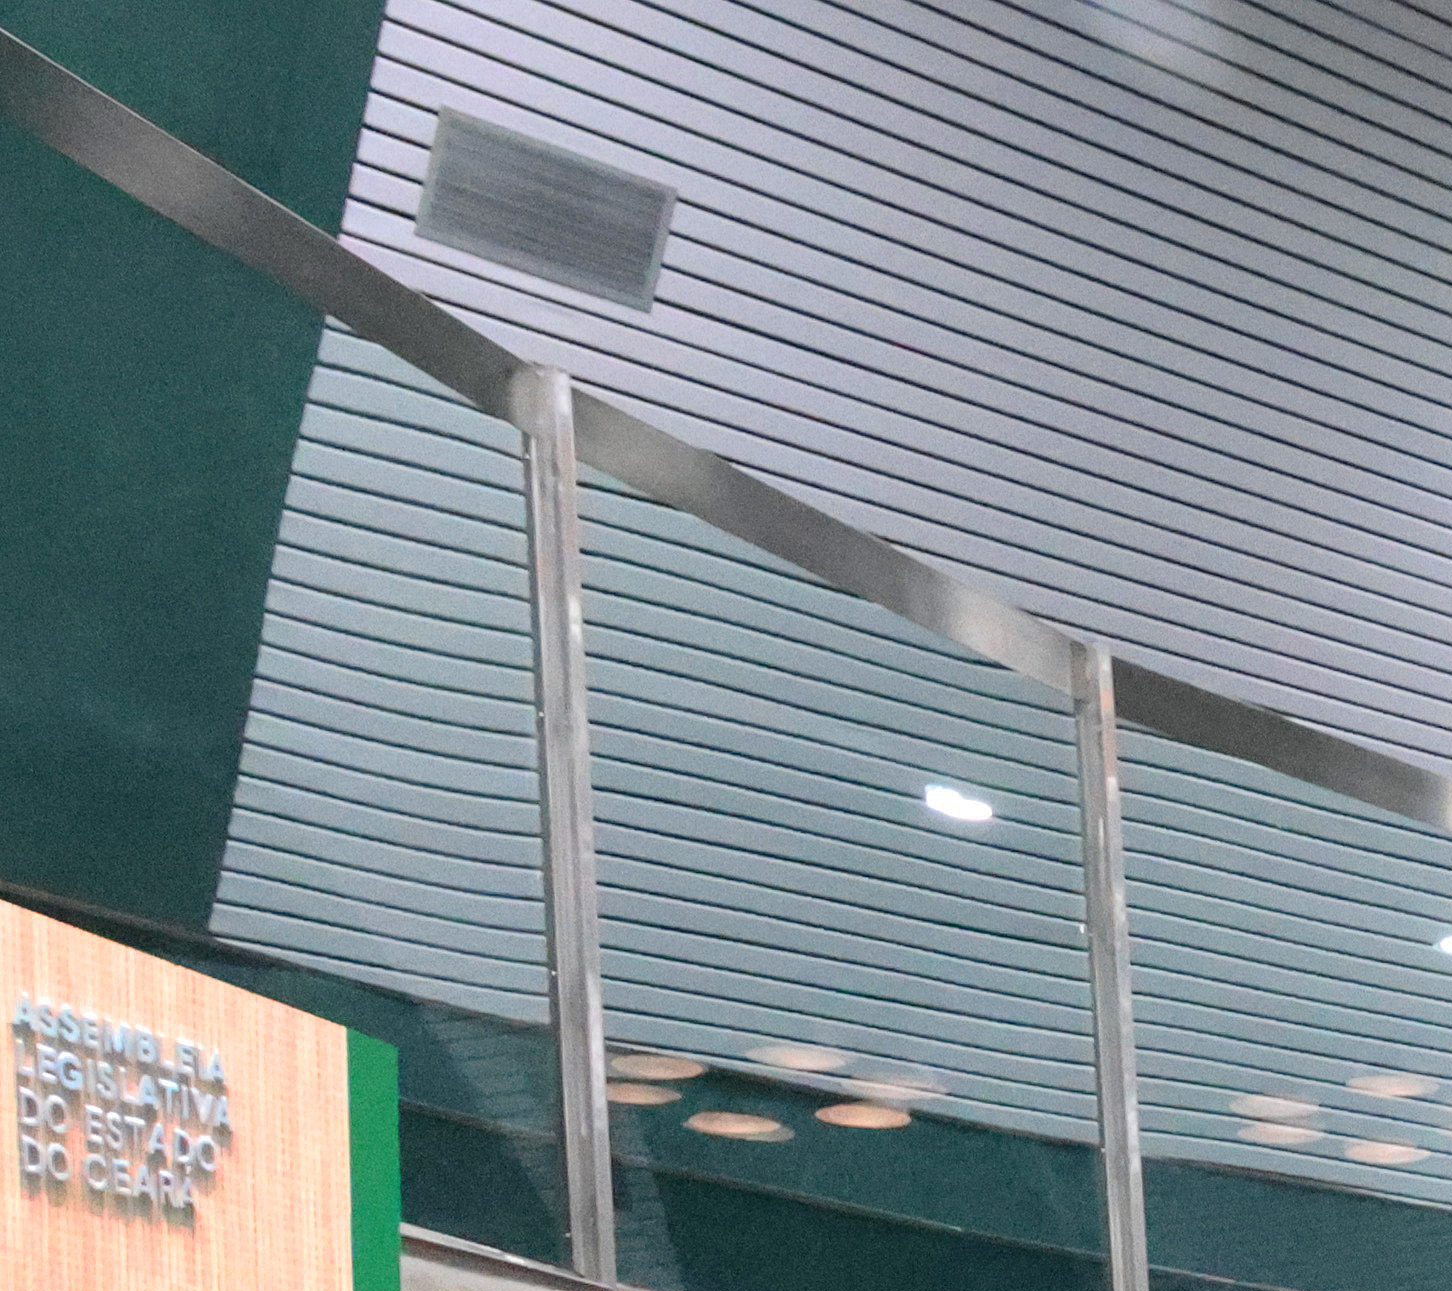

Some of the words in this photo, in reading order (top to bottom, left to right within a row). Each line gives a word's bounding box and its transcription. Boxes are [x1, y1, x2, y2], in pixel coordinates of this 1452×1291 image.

[15, 992, 225, 1081] ASSEMBLEIA
[15, 1039, 230, 1128] LEGISLATIVA
[18, 1086, 69, 1133] DO
[85, 1104, 217, 1172] ESTADO
[21, 1134, 71, 1181] DO
[84, 1154, 193, 1208] CEARÁ
